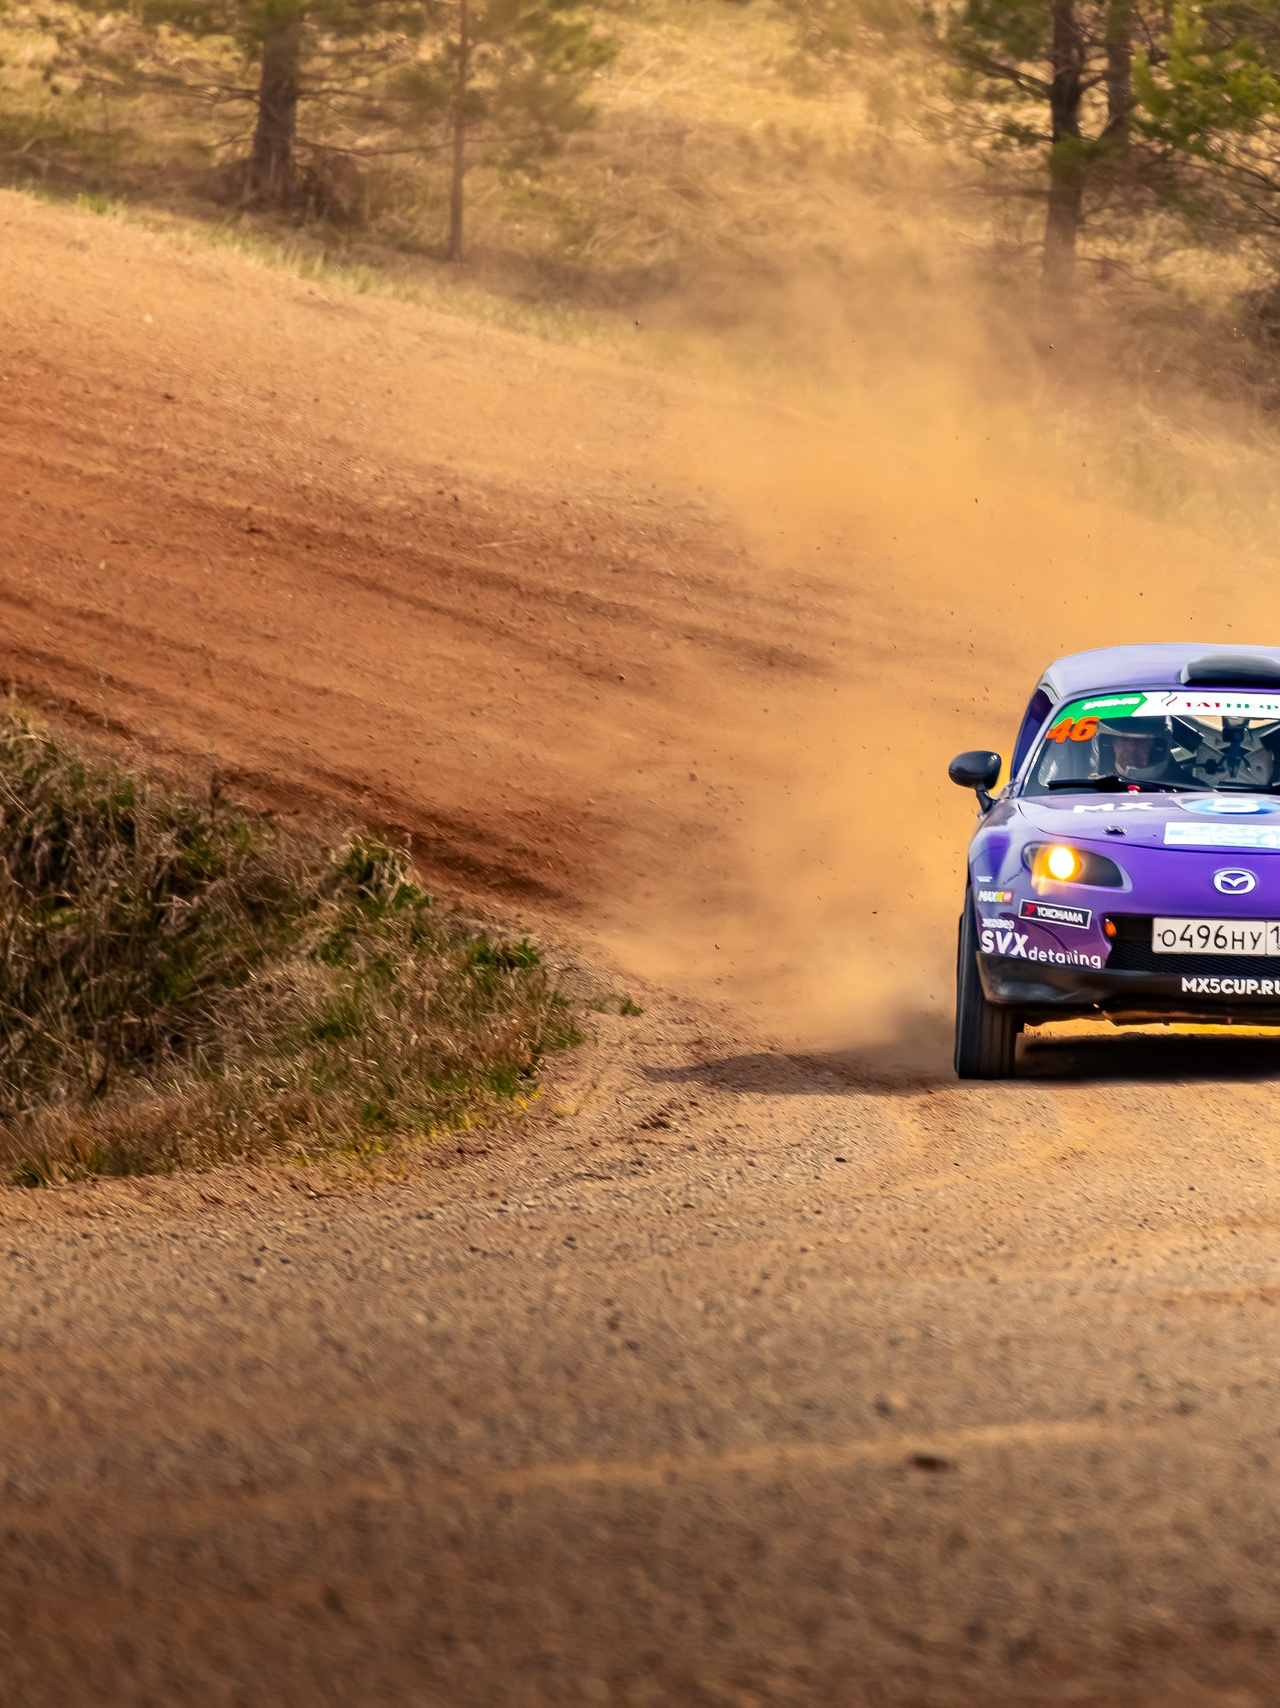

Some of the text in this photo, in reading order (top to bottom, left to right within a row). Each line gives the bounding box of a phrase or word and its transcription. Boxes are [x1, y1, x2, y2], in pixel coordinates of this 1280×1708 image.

[1046, 716, 1100, 744] 46
[1073, 802, 1153, 814] MX
[1036, 906, 1084, 924] YOKOHAMA
[981, 930, 1101, 969] SVX detailing
